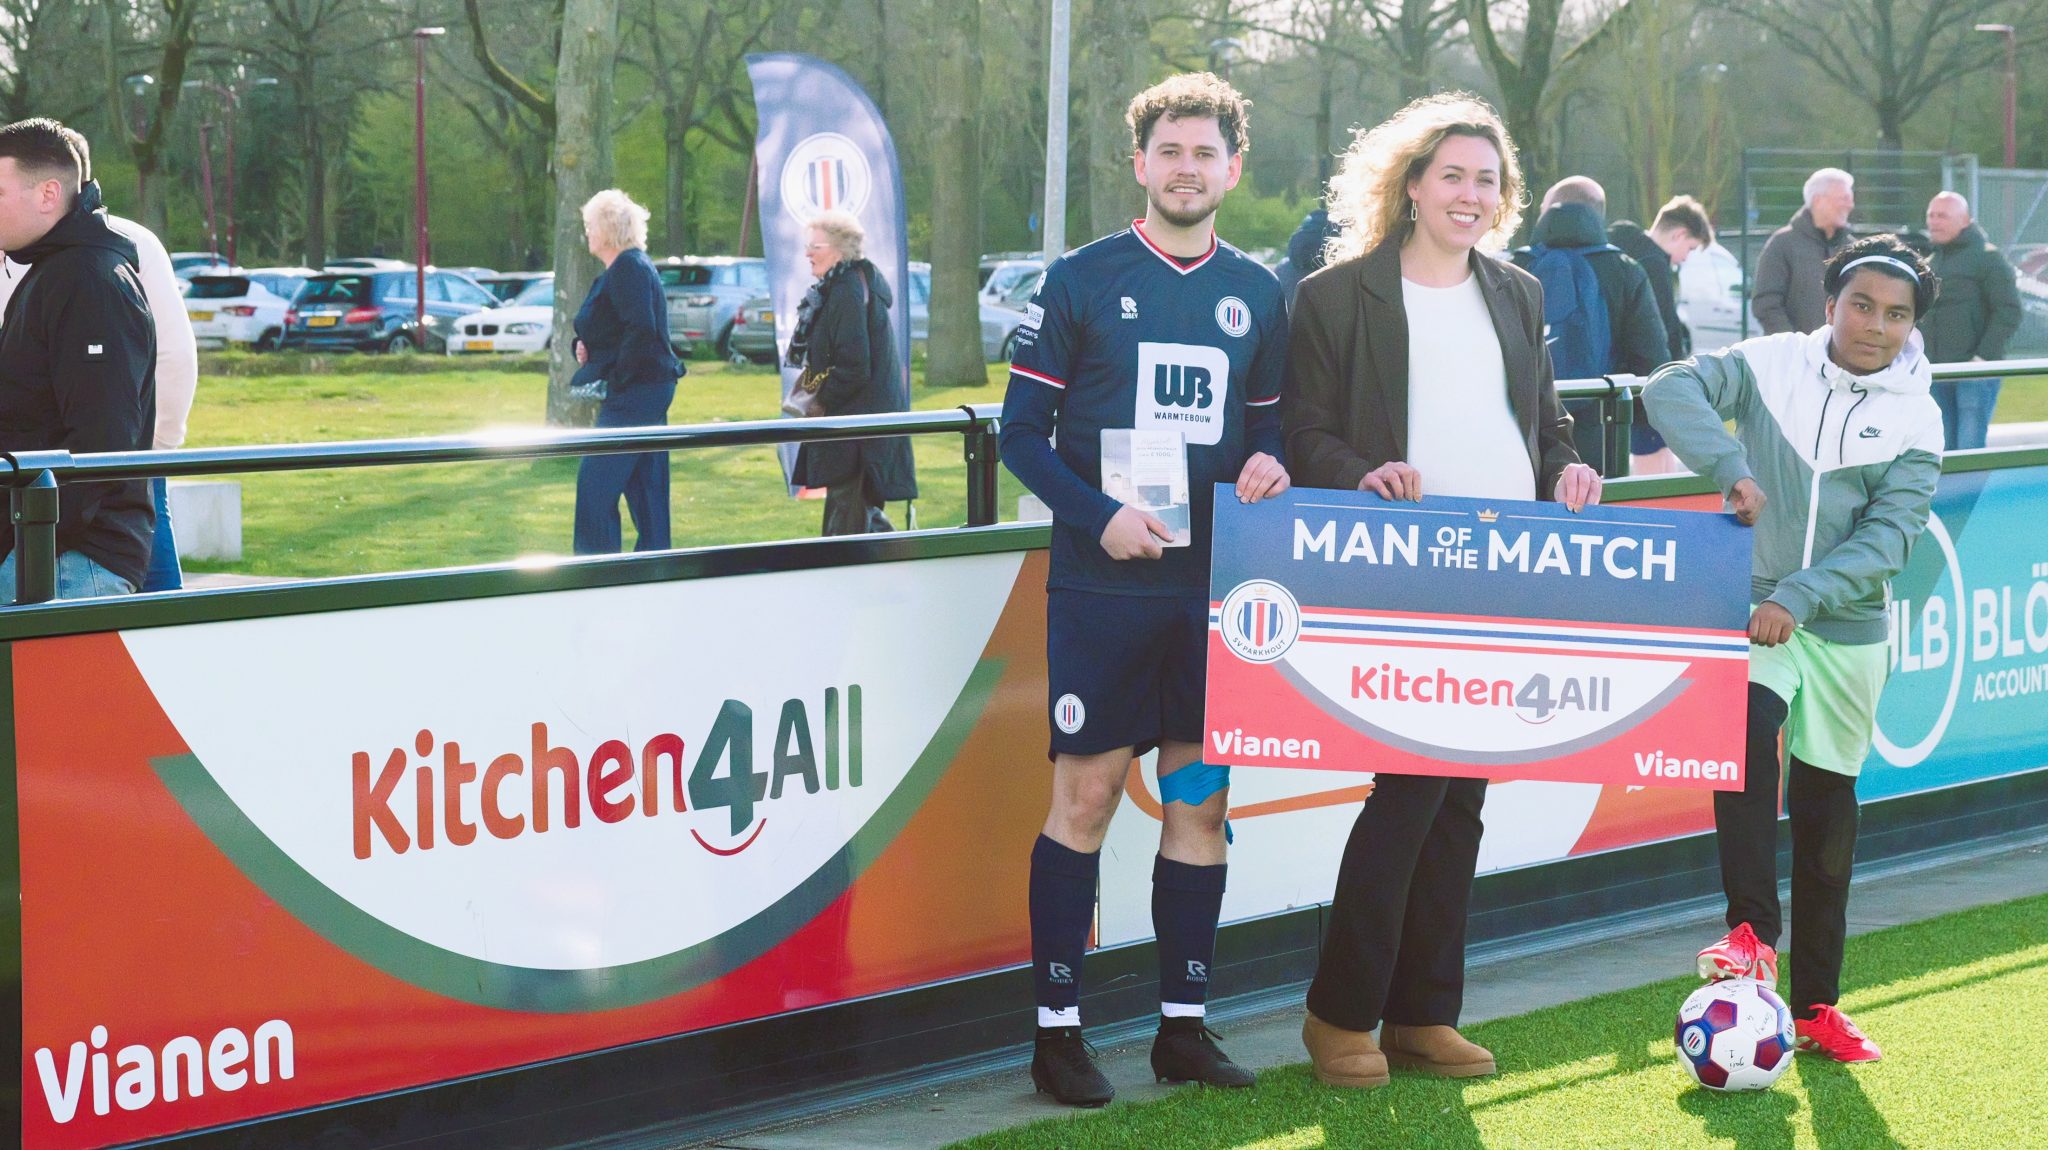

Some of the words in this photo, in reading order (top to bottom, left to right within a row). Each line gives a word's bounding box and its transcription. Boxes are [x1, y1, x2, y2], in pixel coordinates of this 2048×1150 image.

[1154, 364, 1213, 409] WB
[1154, 412, 1211, 423] WARMTEBOUW
[1864, 426, 1882, 436] NIKE
[1293, 518, 1420, 566] MAN
[1436, 526, 1472, 548] OF
[1428, 547, 1478, 570] THE
[1487, 530, 1677, 582] MATCH
[1232, 637, 1243, 647] SV
[1242, 639, 1287, 656] PARKHOUT
[1350, 662, 1610, 719] Kitchen4All
[1212, 728, 1321, 759] Vianen
[352, 684, 862, 860] Kitchen4All
[1634, 749, 1738, 781] Vianen
[34, 1019, 294, 1124] Vianen
